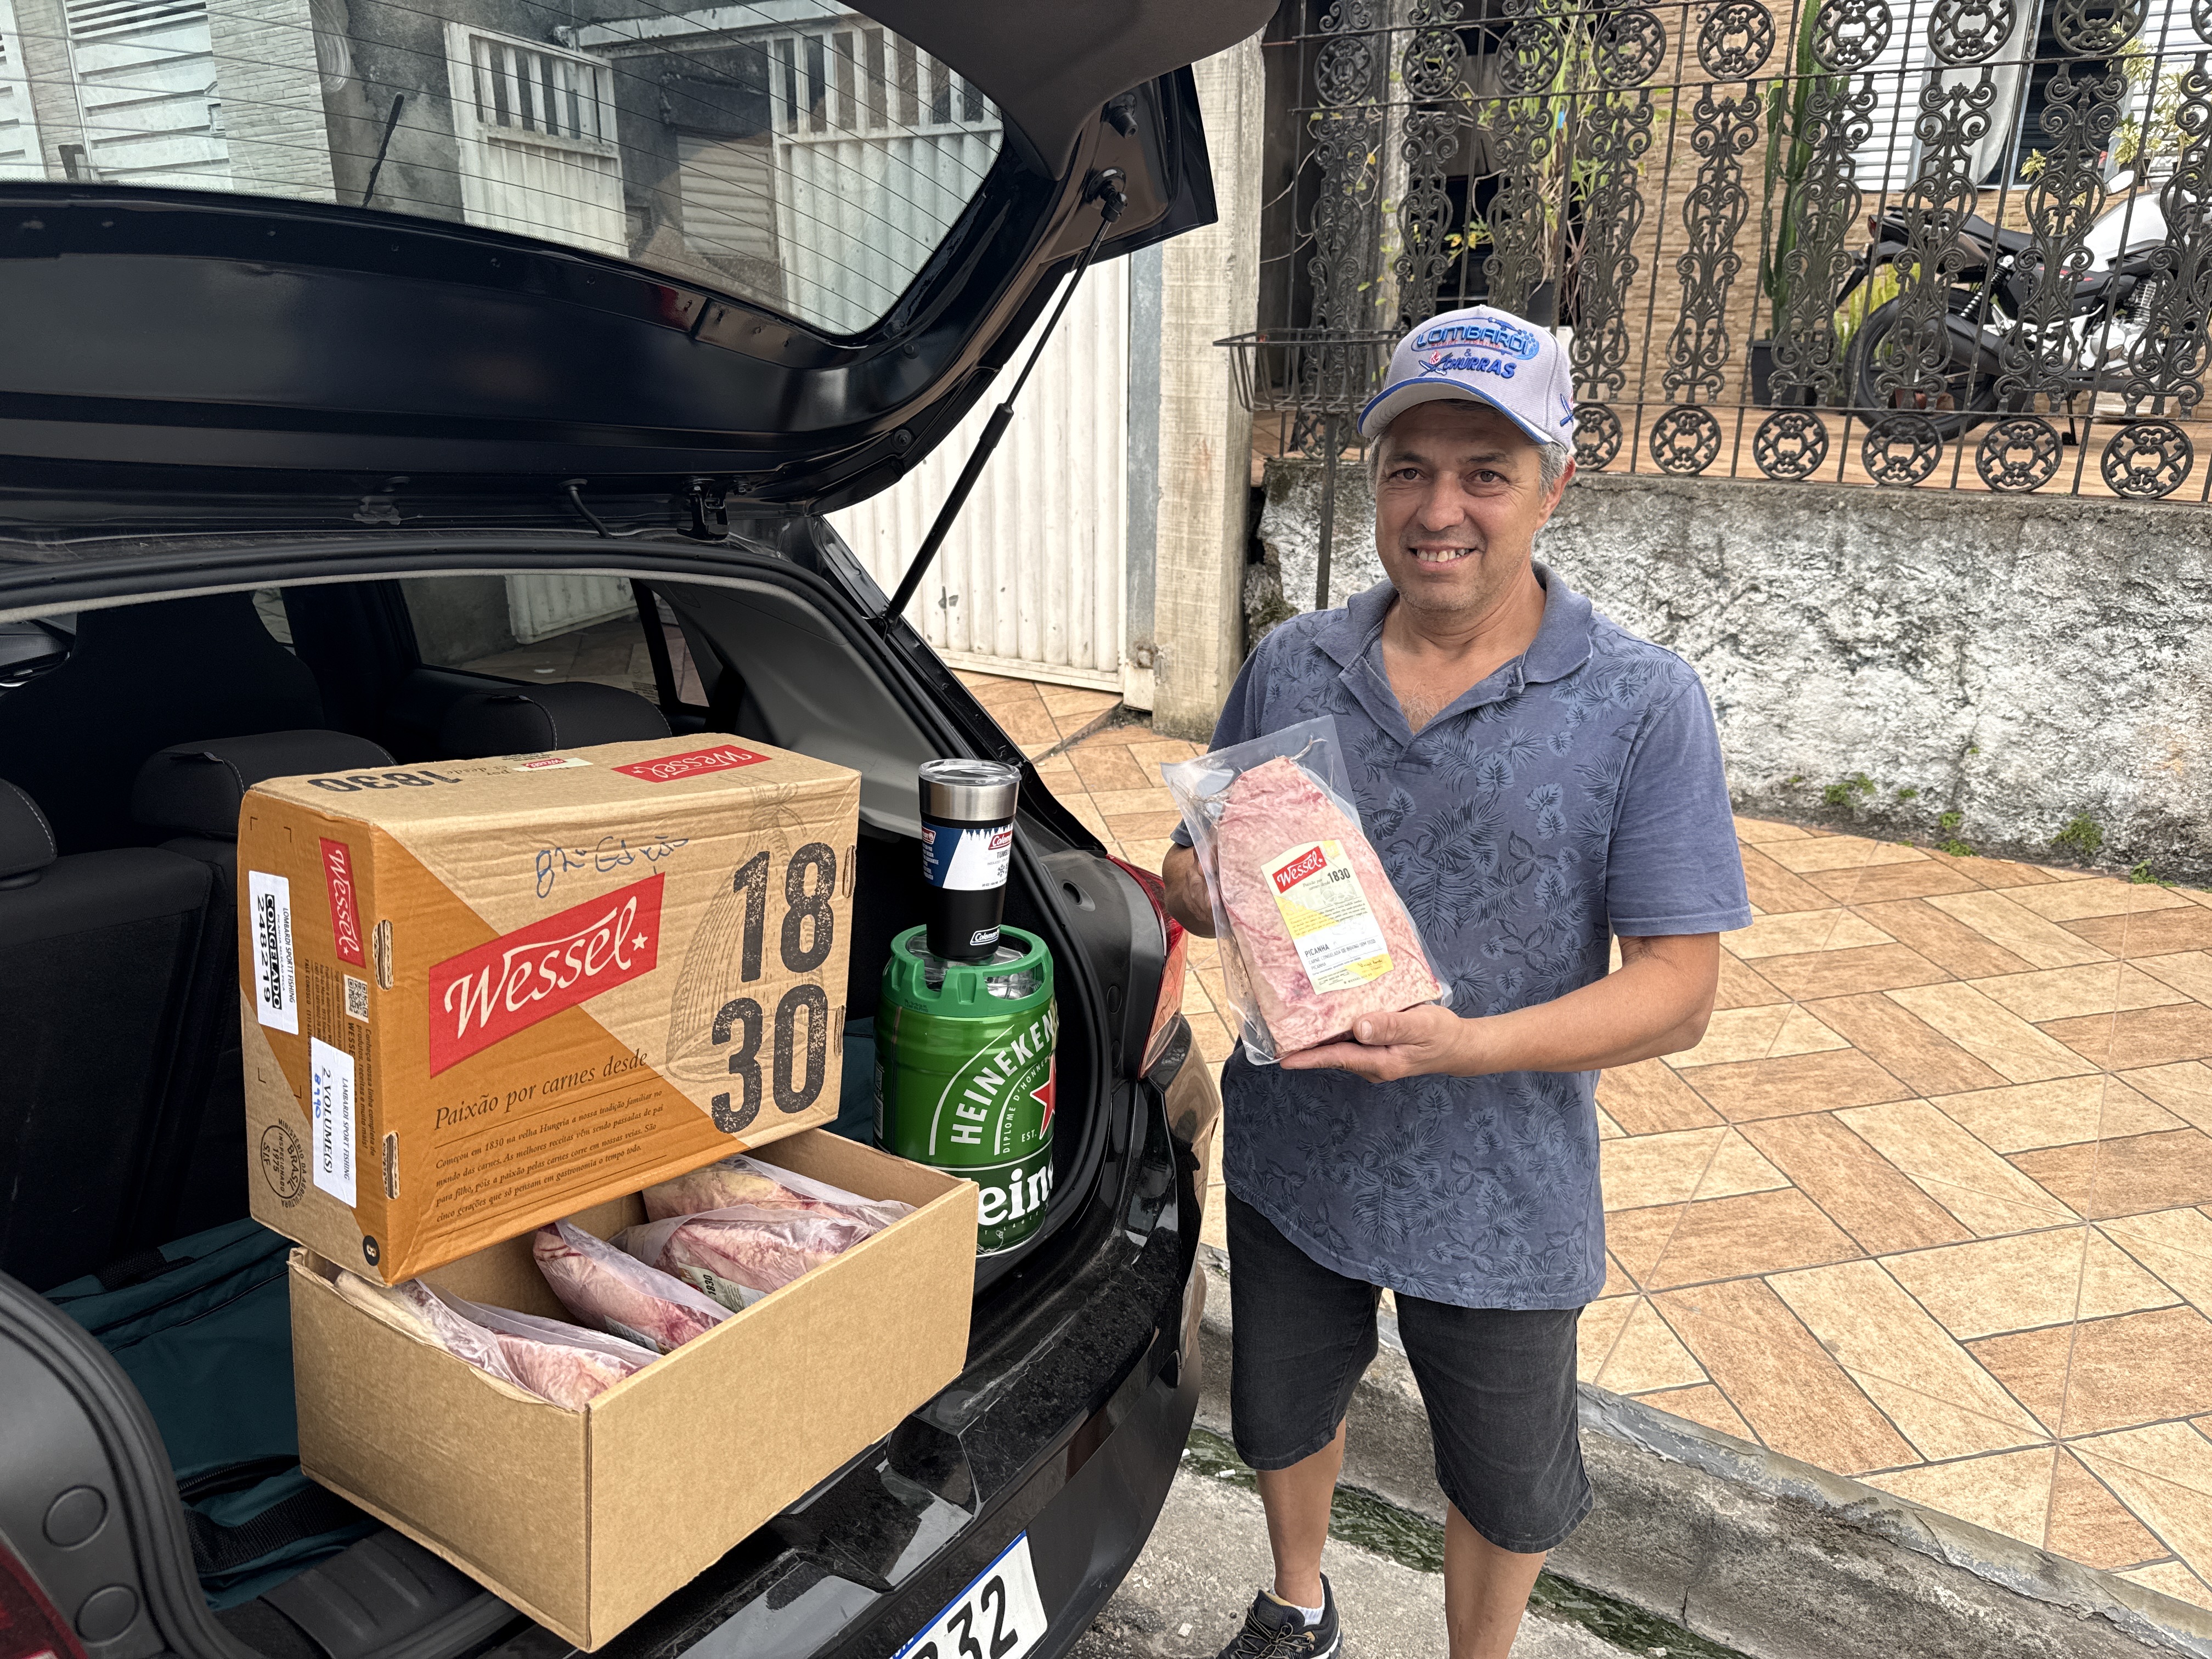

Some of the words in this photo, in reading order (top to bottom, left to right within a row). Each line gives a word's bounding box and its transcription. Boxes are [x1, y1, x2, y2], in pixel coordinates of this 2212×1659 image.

[1417, 325, 1528, 354] LOMBARDI
[1464, 348, 1471, 357] &
[1443, 357, 1517, 379] CHURRAS
[307, 770, 464, 792] 1830
[633, 751, 752, 778] Wessel
[1277, 850, 1322, 887] Wessel
[1328, 868, 1351, 883] 1830
[329, 850, 359, 952] Wessel
[733, 842, 837, 983] 18
[283, 907, 292, 945] LOMBARDI
[975, 932, 998, 941] Coleman
[257, 895, 270, 1003] 248219
[266, 895, 281, 1009] CONGELADO
[285, 946, 294, 973] SPORTT
[444, 895, 637, 1039] Wessel
[1305, 943, 1330, 957] PICANHA
[323, 1069, 330, 1079] 2
[712, 984, 828, 1133] 30
[951, 1009, 1054, 1144] HEINEKEN
[434, 1092, 498, 1131] Paixão
[504, 1084, 537, 1113] por
[542, 1066, 595, 1095] carnes
[603, 1048, 647, 1077] desde
[324, 1085, 332, 1173] VOLUME(S)
[436, 1152, 469, 1169] Começou
[471, 1147, 482, 1156] em
[485, 1138, 504, 1152] 1830
[506, 1136, 516, 1144] na
[518, 1128, 537, 1140] velha
[540, 1118, 569, 1133] Hungria
[579, 1109, 597, 1121] nossa
[600, 1101, 625, 1114] tradição
[625, 1093, 652, 1109] familiar
[436, 1171, 460, 1187] mundo
[463, 1167, 475, 1177] das
[503, 1153, 514, 1163] As
[516, 1143, 547, 1158] melhores
[549, 1134, 574, 1148] receitas
[592, 1121, 611, 1133] sendo
[613, 1112, 642, 1128] passadas
[644, 1108, 651, 1116] de
[653, 1103, 664, 1116] pai
[1003, 1107, 1015, 1154] DIPLOME
[1022, 1129, 1037, 1143] EST.
[287, 1144, 299, 1190] BRASIL
[301, 1163, 307, 1174] DA
[436, 1194, 453, 1207] para
[475, 1178, 490, 1193] pois
[499, 1167, 525, 1184] paixão
[526, 1160, 545, 1175] pelas
[547, 1153, 569, 1165] carnes
[571, 1147, 588, 1157] corre
[602, 1135, 623, 1147] nossas
[644, 1123, 657, 1133] São
[437, 1210, 455, 1222] cinco
[457, 1199, 486, 1217] gerações
[489, 1193, 502, 1205] que
[514, 1180, 541, 1197] pensam
[544, 1175, 554, 1183] em
[555, 1159, 597, 1182] gastronomia
[605, 1150, 625, 1163] tempo
[281, 1177, 307, 1209] AGRICULTURA
[703, 1274, 716, 1295] 1830
[911, 1575, 1018, 1659] 32
